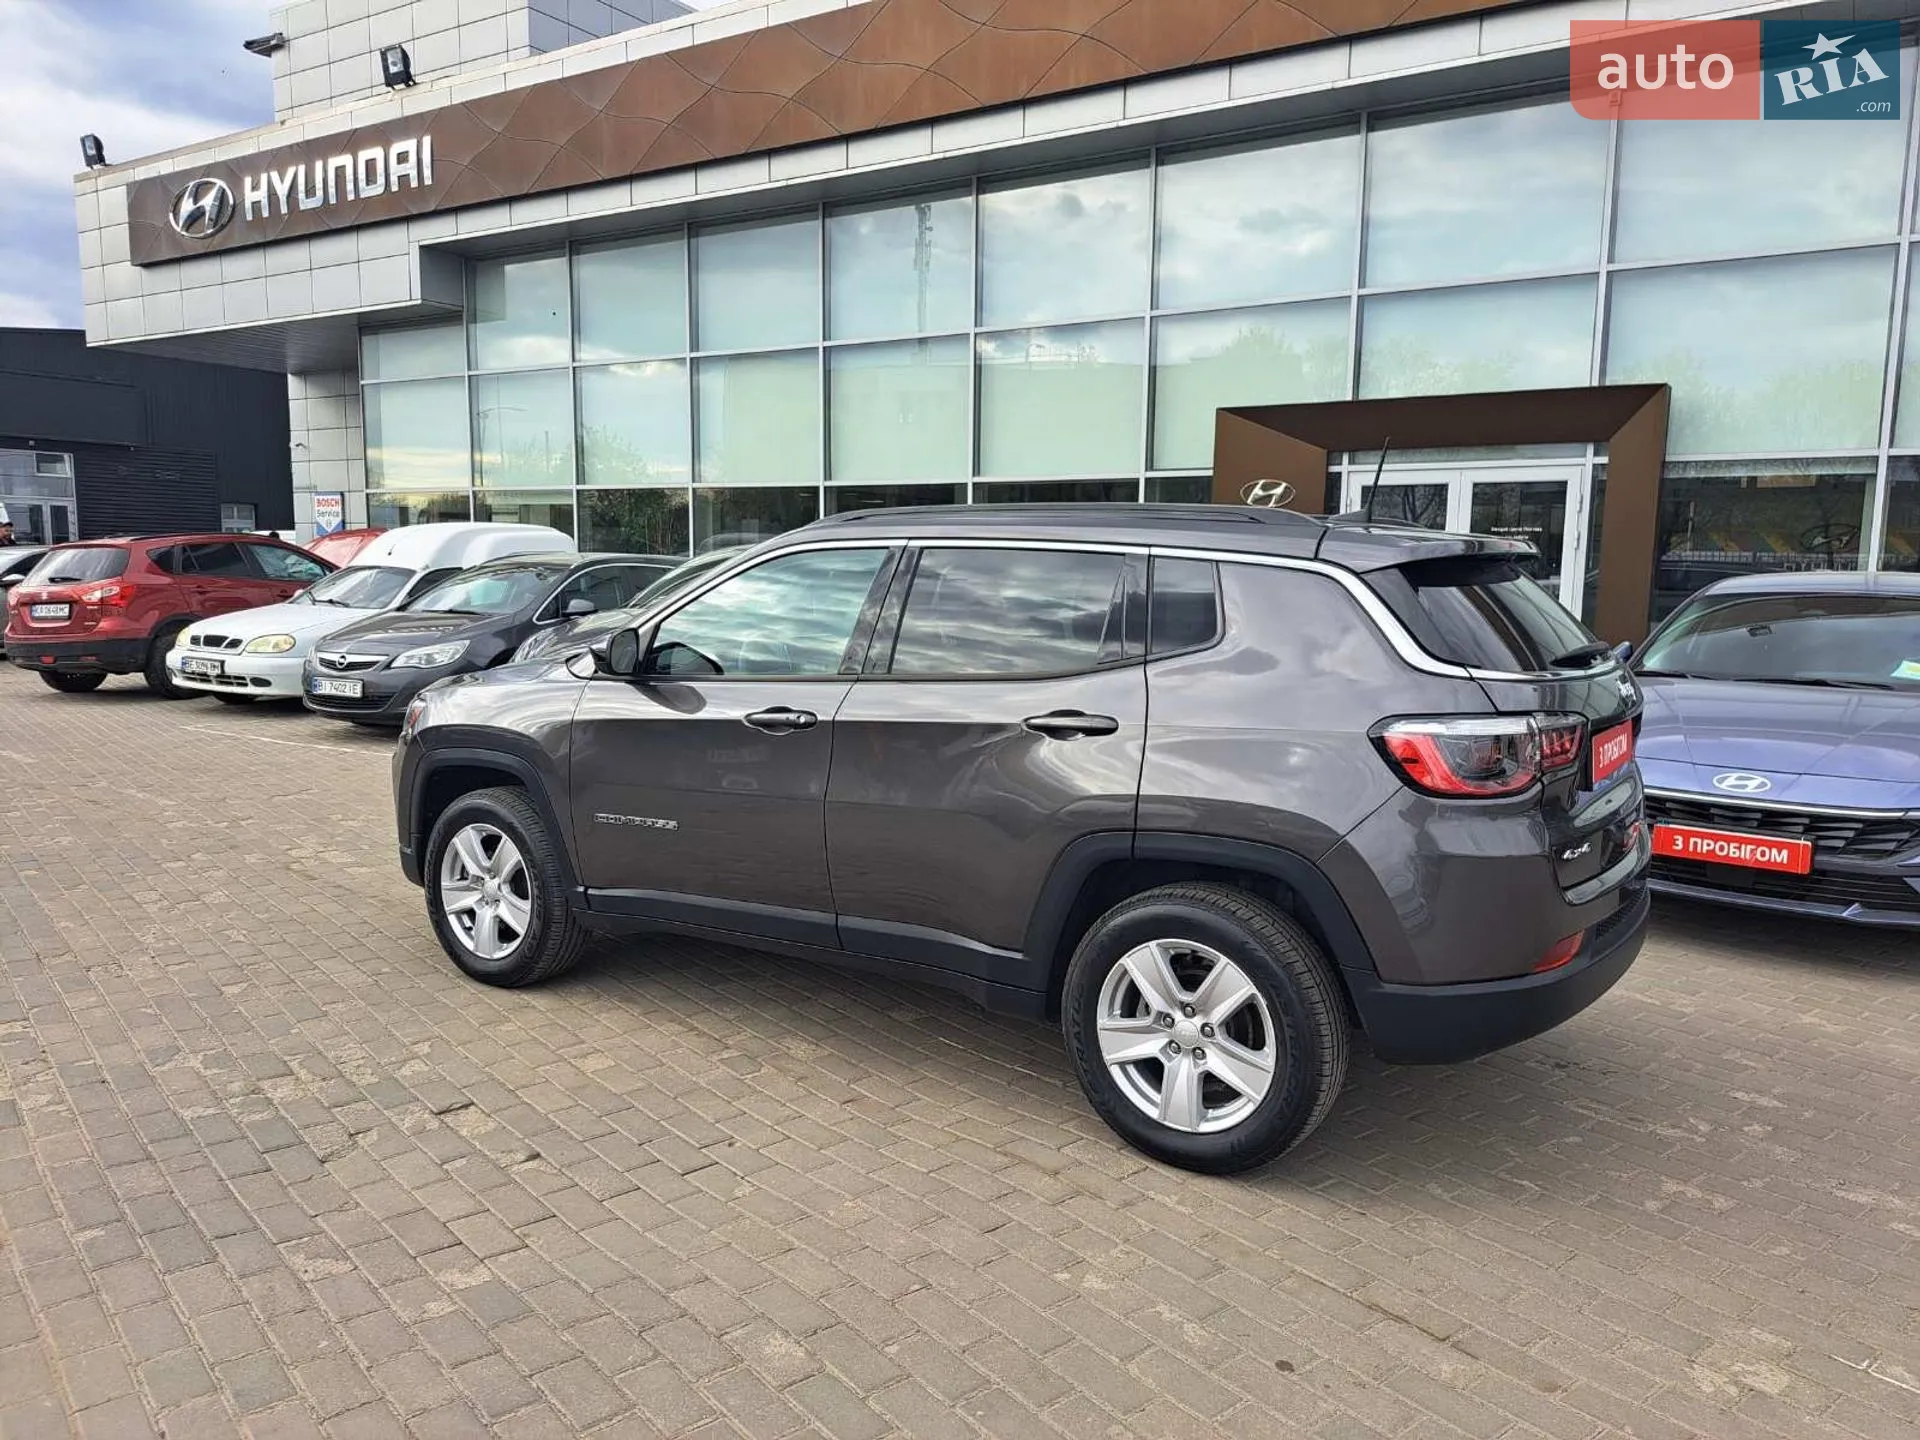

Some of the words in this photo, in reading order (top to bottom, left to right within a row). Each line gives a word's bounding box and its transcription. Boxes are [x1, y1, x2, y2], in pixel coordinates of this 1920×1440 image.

[244, 135, 432, 221] HYUNDAI
[316, 497, 339, 508] BOSCH
[316, 509, 340, 518] Service
[1688, 836, 1789, 865] ПРОБІГОМ
